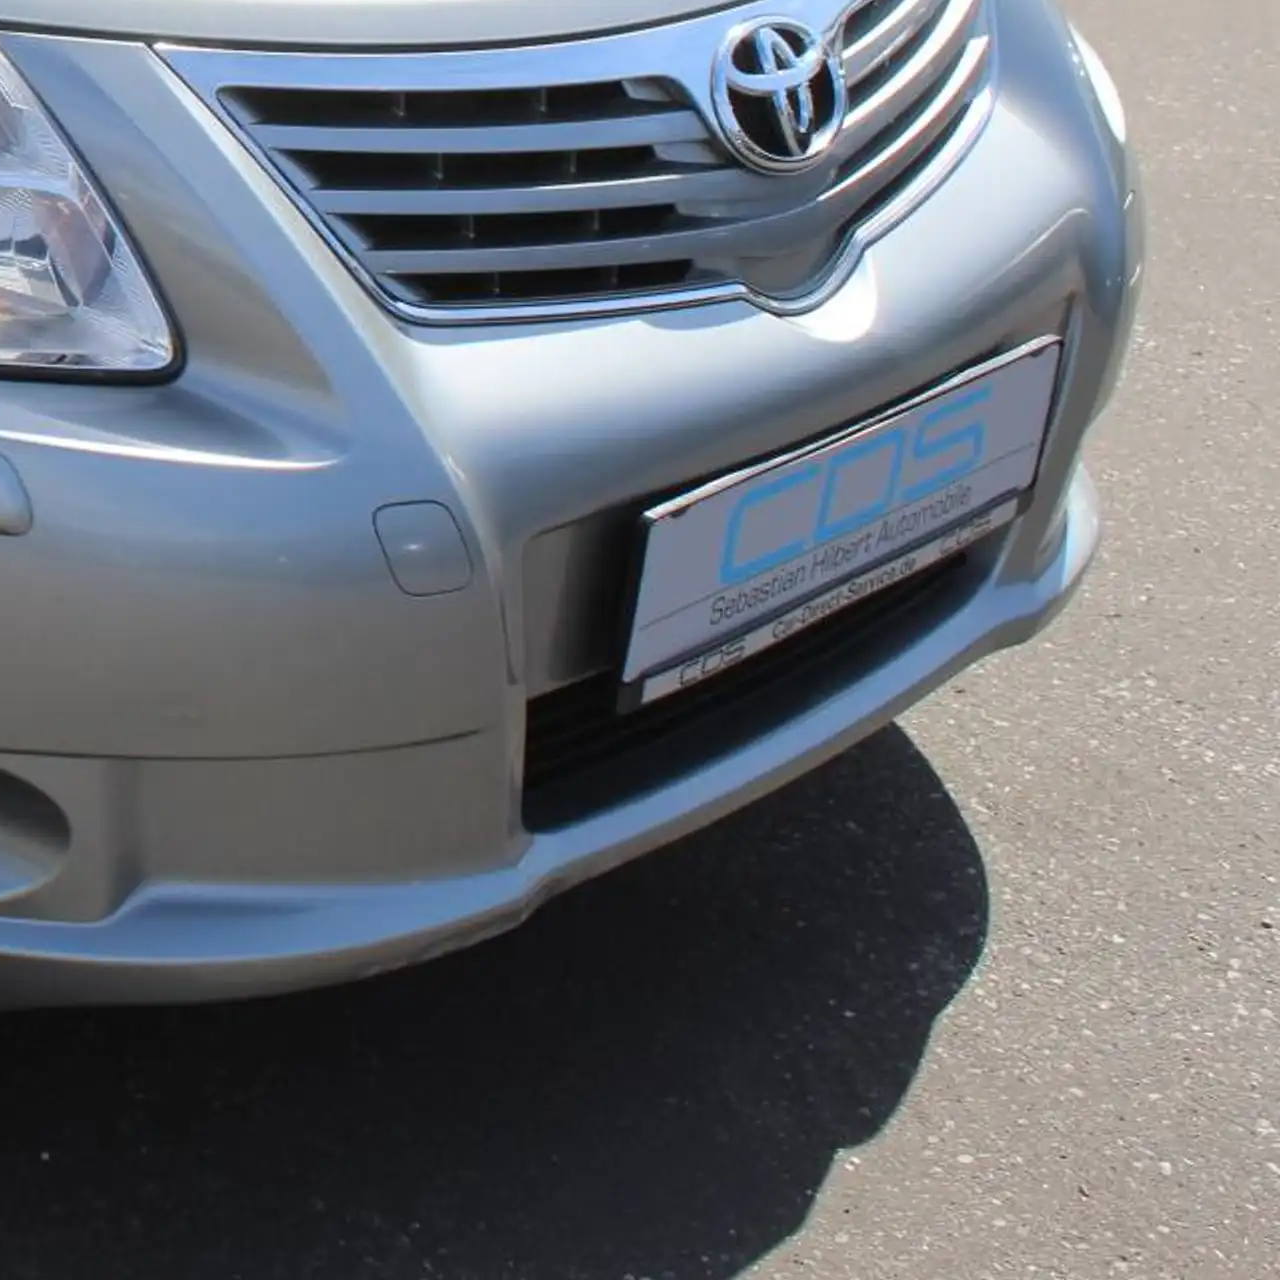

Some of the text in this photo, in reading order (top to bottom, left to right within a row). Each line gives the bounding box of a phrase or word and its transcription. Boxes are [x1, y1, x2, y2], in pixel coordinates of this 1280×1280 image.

[709, 482, 973, 625] Sebastian Hilbert Automobile
